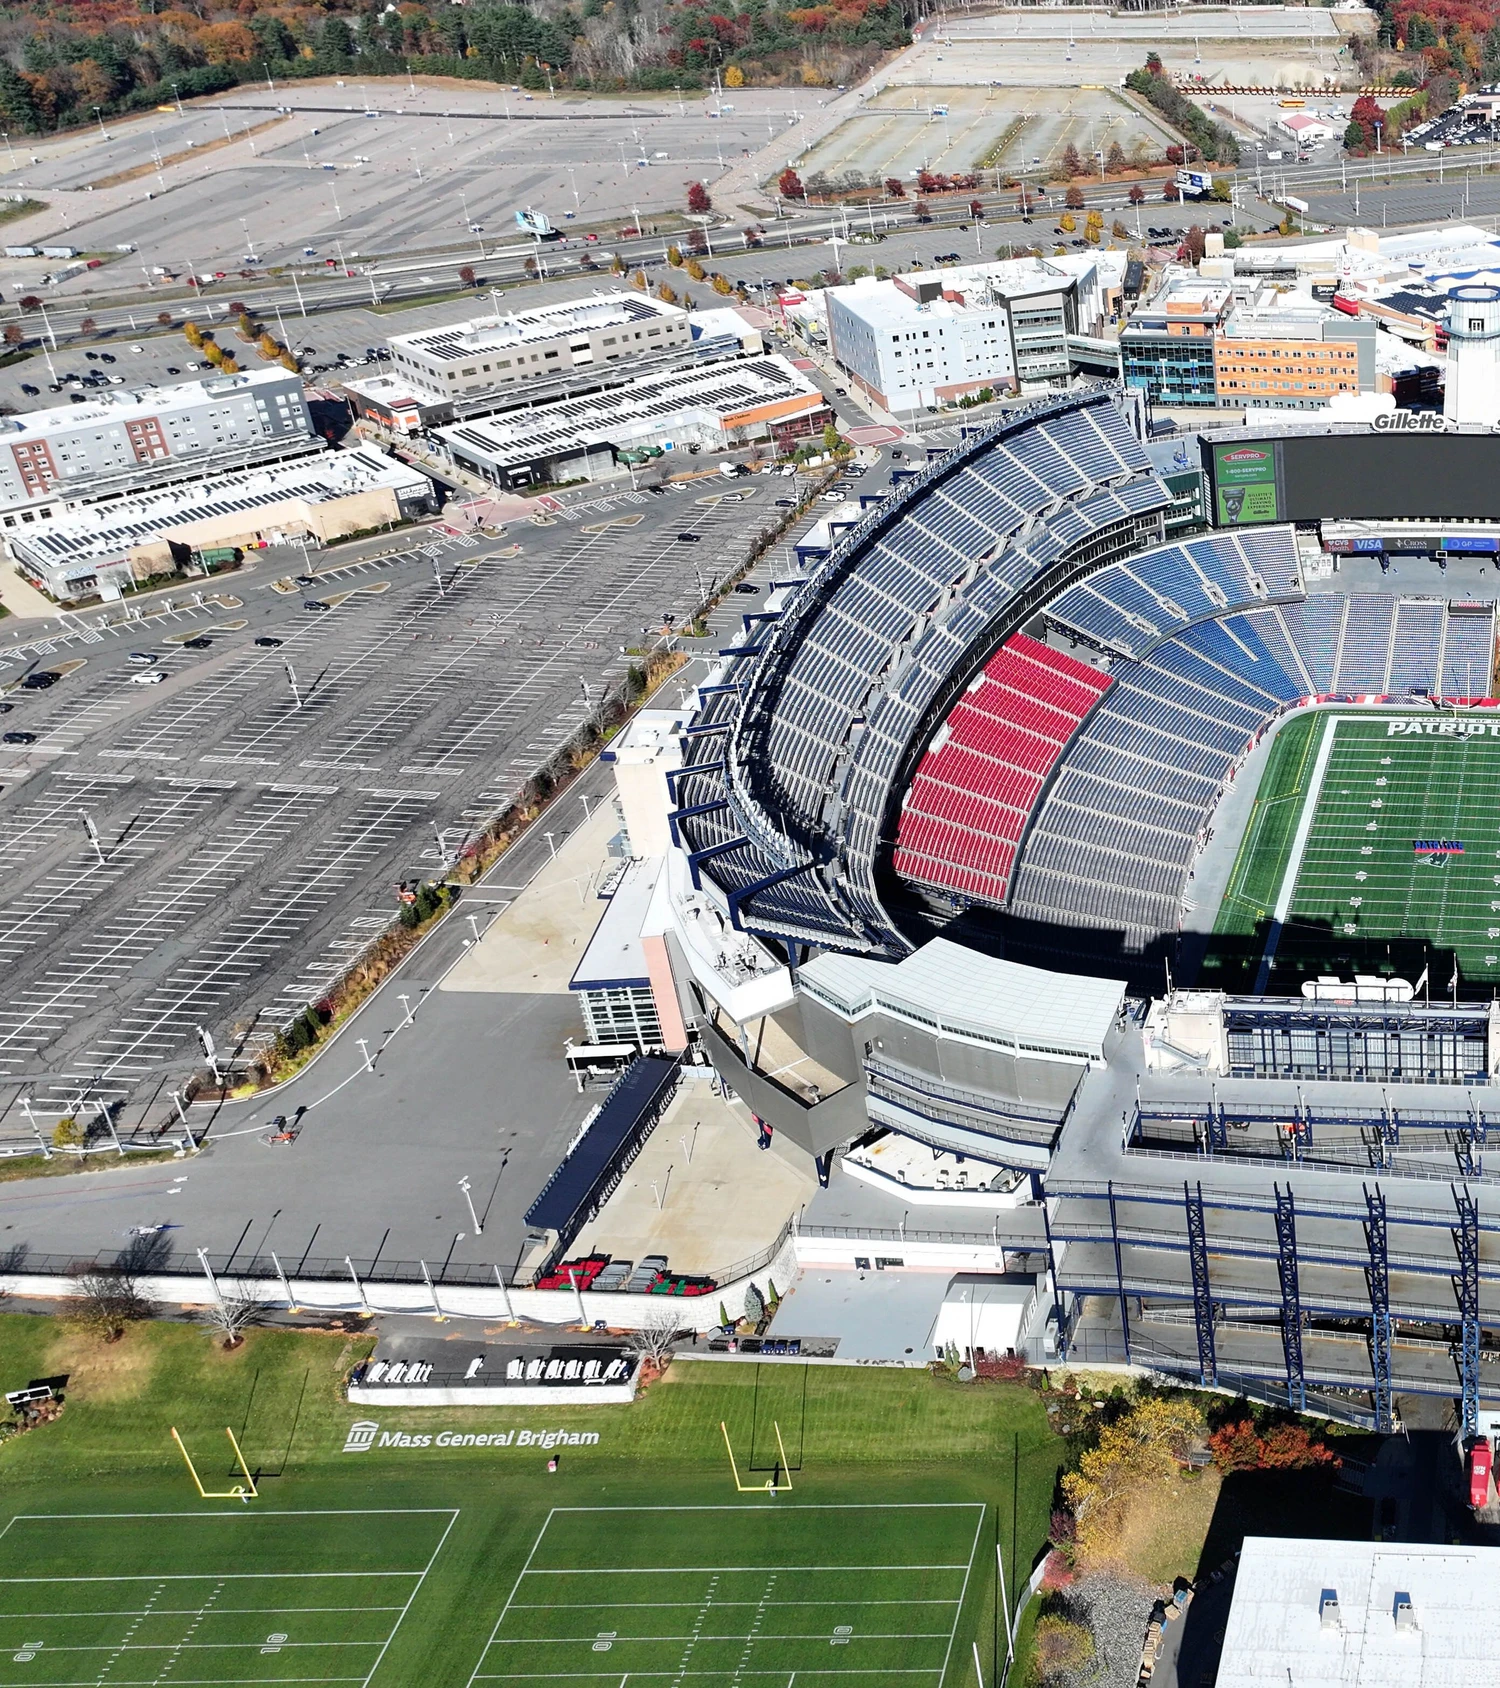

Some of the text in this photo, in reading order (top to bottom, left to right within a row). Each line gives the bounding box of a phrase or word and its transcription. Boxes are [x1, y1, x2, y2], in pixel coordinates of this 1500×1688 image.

[1374, 413, 1444, 429] Gillette
[1355, 540, 1382, 549] VISA
[378, 1429, 600, 1449] Mass General Brigham
[260, 1634, 288, 1654] 10
[592, 1631, 617, 1651] 10
[830, 1626, 853, 1645] 10
[13, 1641, 44, 1662] 10
